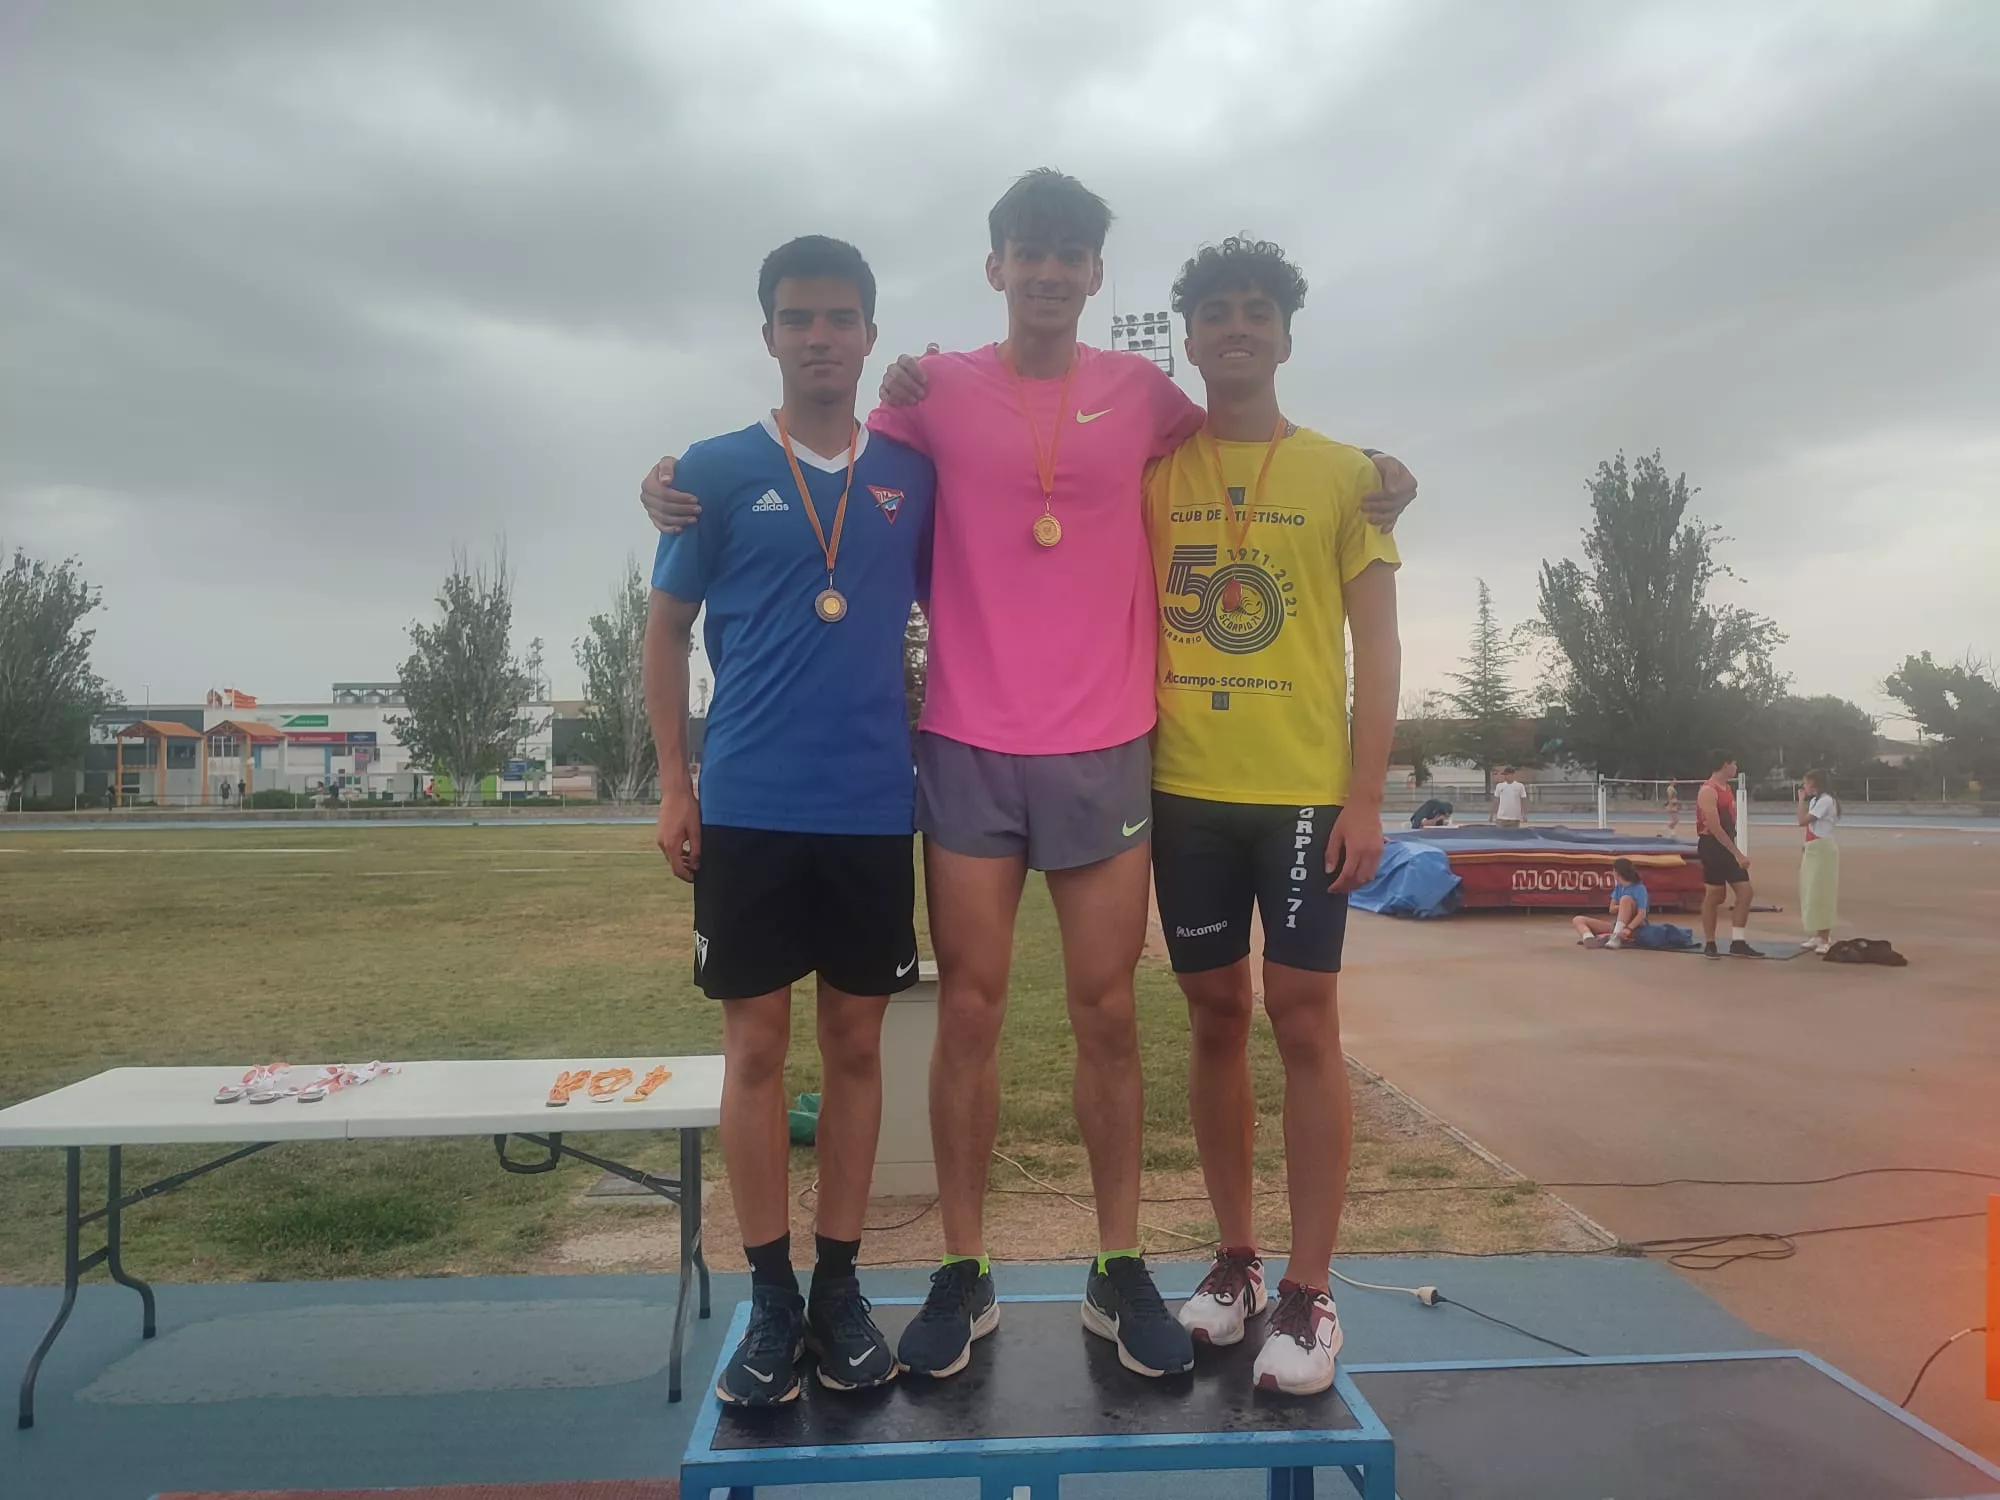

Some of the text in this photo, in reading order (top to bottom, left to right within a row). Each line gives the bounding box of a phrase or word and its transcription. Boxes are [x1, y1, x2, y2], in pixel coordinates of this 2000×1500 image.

[752, 503, 790, 512] adidas
[1170, 509, 1306, 526] CLUB DE TLETISMO
[1163, 544, 1285, 655] 50
[1512, 869, 1617, 891] MONDO
[1176, 920, 1228, 938] Alcampo
